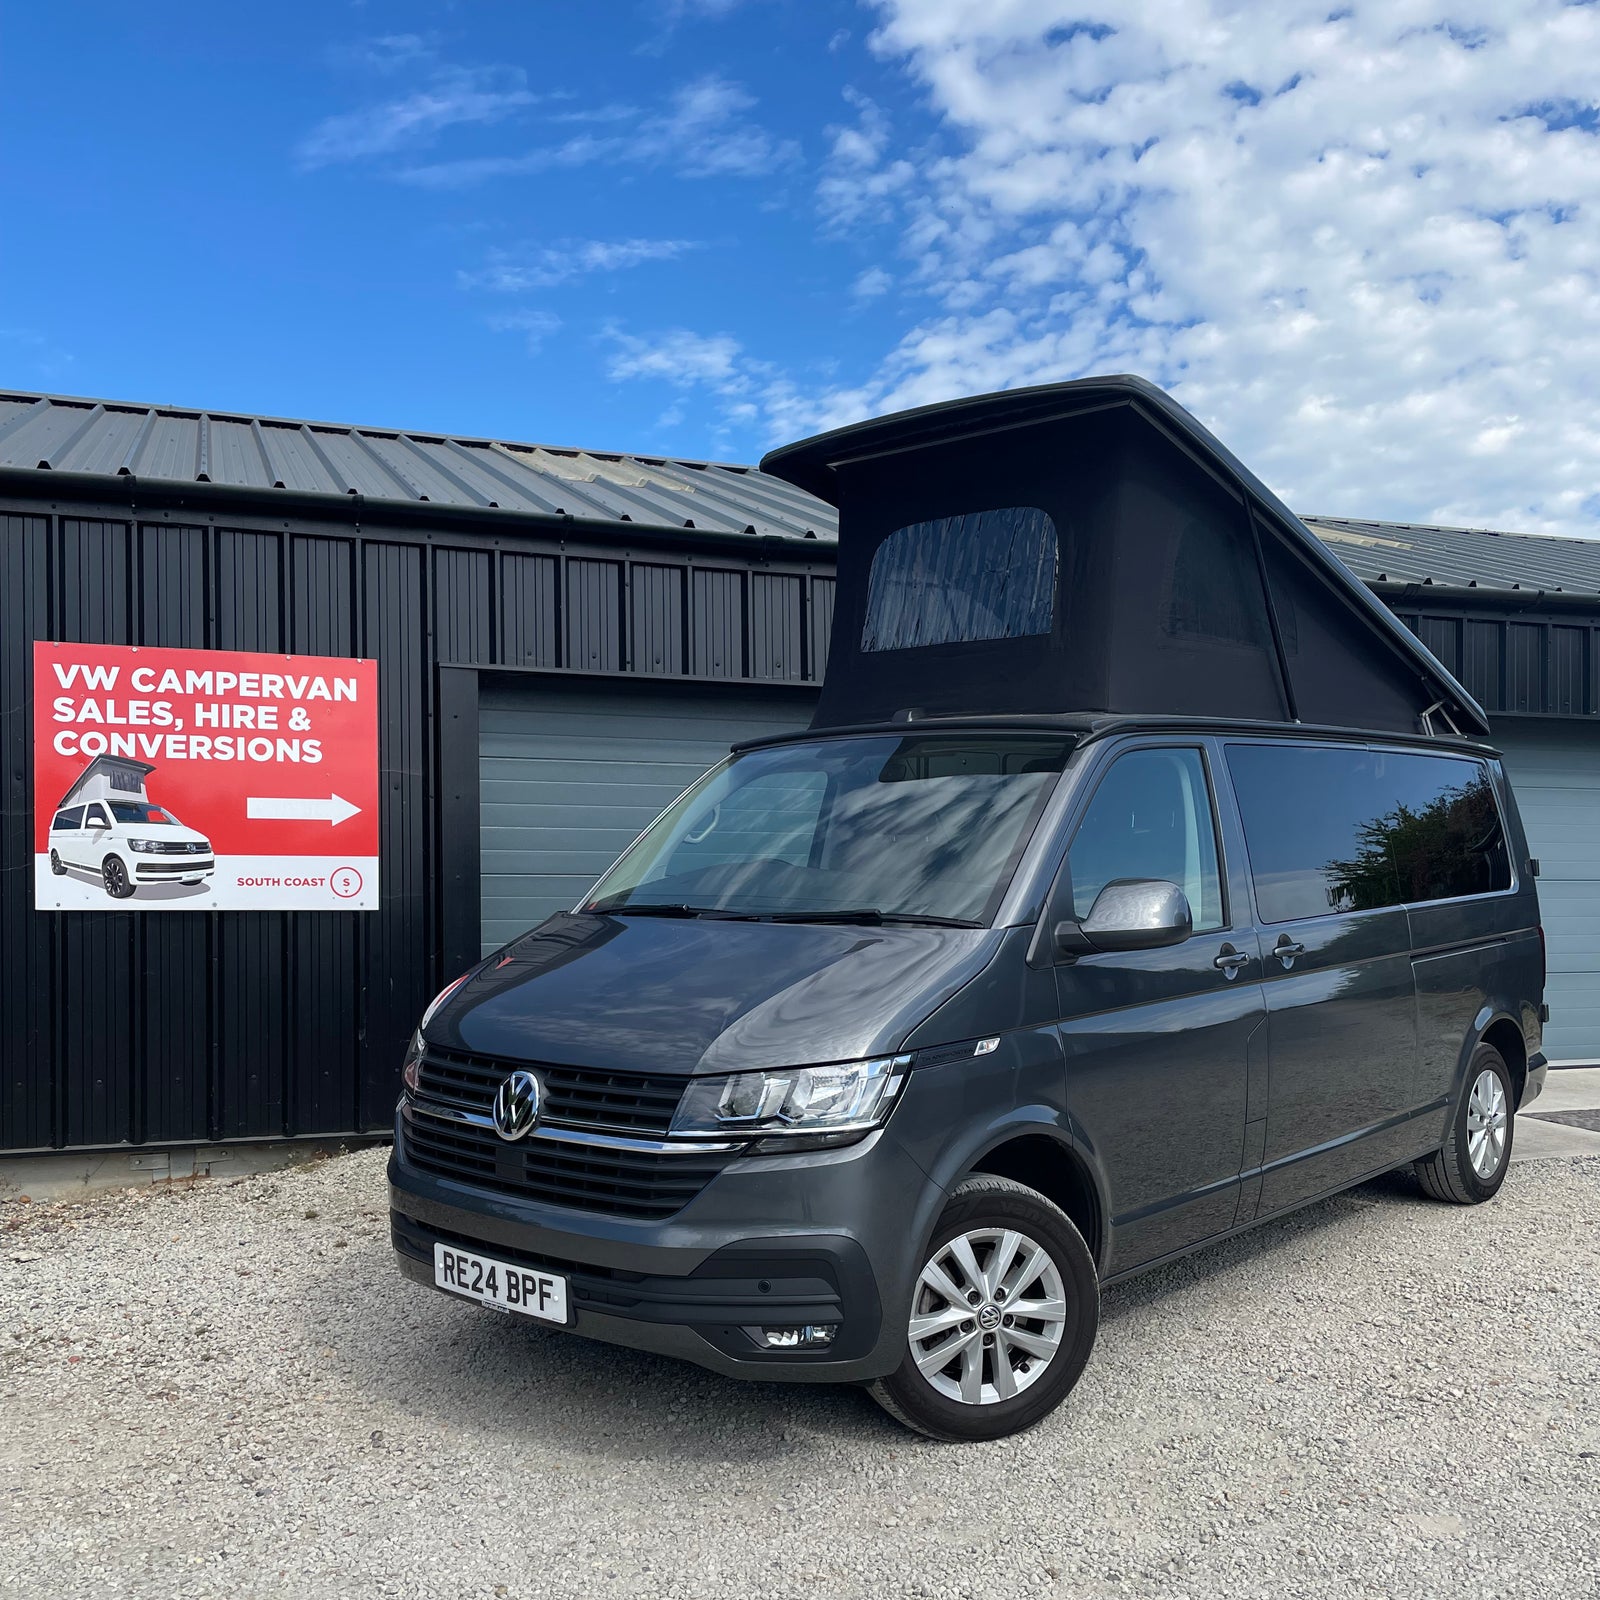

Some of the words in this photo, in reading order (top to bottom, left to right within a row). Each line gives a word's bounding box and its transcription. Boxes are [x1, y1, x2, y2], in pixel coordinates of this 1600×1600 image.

[52, 663, 120, 691] VW
[130, 667, 358, 702] CAMPERVAN
[52, 697, 184, 731] SALES,
[195, 703, 278, 730] HIRE
[289, 707, 312, 731] &
[53, 730, 323, 763] CONVERSIONS
[237, 877, 281, 887] SOUTH
[284, 877, 326, 887] COAST
[342, 877, 351, 888] S
[443, 1250, 499, 1298] RE24
[505, 1269, 553, 1312] BPF
